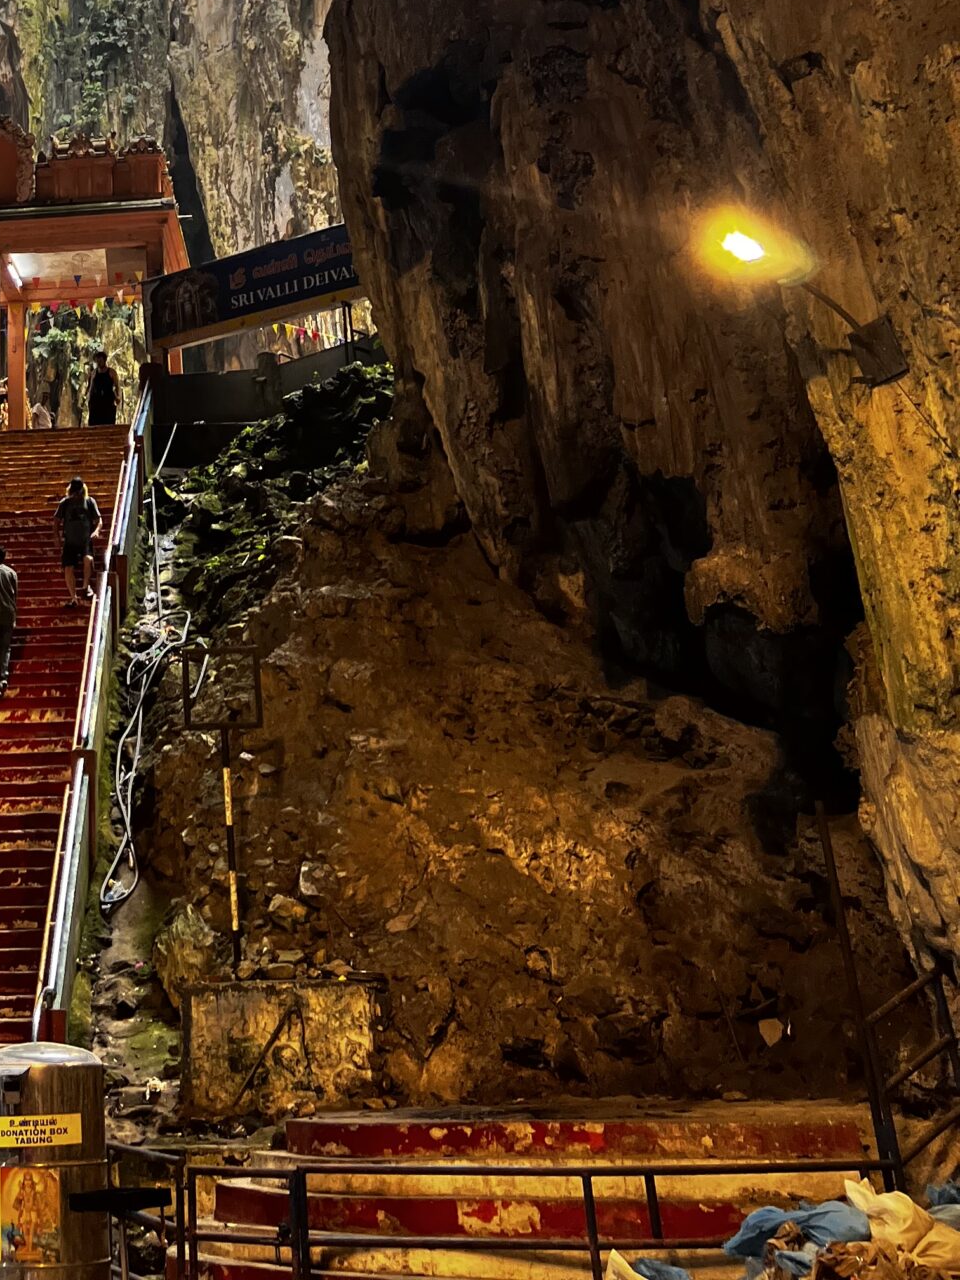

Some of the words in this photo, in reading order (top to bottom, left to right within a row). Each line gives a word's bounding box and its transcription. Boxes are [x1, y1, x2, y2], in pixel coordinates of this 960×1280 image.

[230, 291, 255, 310] SRI
[256, 280, 299, 301] VALLI
[1, 1129, 46, 1137] DONATION
[50, 1127, 68, 1135] BOX
